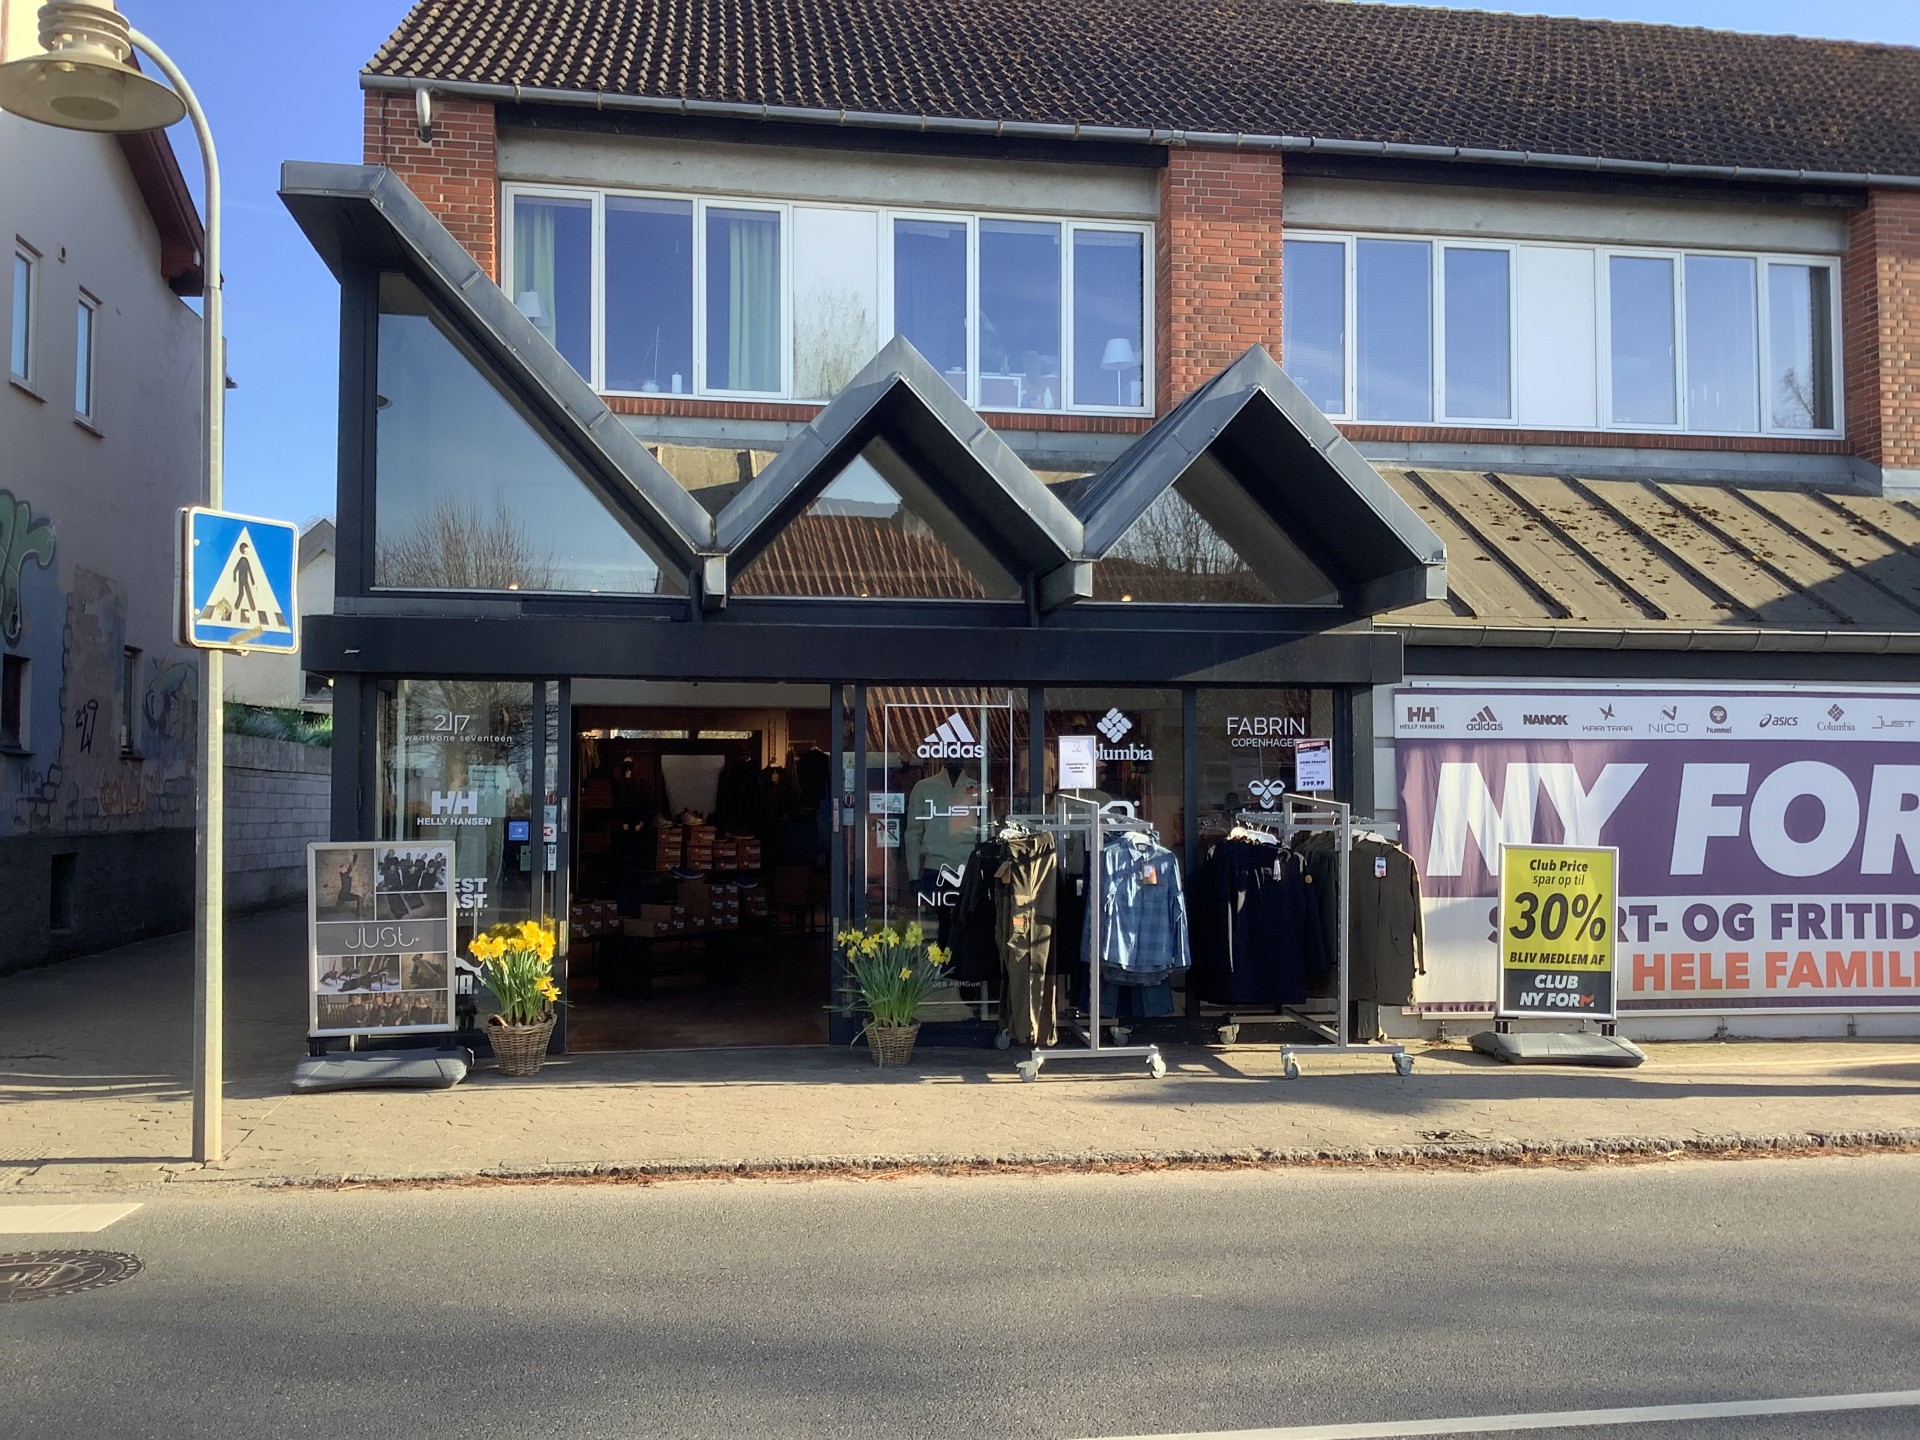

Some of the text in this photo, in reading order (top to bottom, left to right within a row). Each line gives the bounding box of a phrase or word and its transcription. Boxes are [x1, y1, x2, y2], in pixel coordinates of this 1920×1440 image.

[1226, 717, 1305, 736] FABRIN
[1466, 721, 1503, 731] adidas
[1523, 714, 1568, 726] NANOK
[1817, 721, 1856, 732] Columbia
[1648, 723, 1689, 733] NICO
[1706, 726, 1732, 734] hummel
[916, 741, 985, 759] adidas
[417, 818, 491, 826] HELLY HANSEN
[1426, 762, 1650, 877] NY
[1529, 859, 1589, 873] Club Price
[1532, 874, 1585, 888] spar op til
[1508, 891, 1606, 942] 30%
[1682, 902, 1755, 942] OG
[1770, 903, 1920, 940] FRITID
[1509, 952, 1606, 966] BLIV MEDLEM AF
[1632, 951, 1751, 991] HELE
[1534, 974, 1579, 989] CLUB
[1519, 992, 1544, 1006] NY
